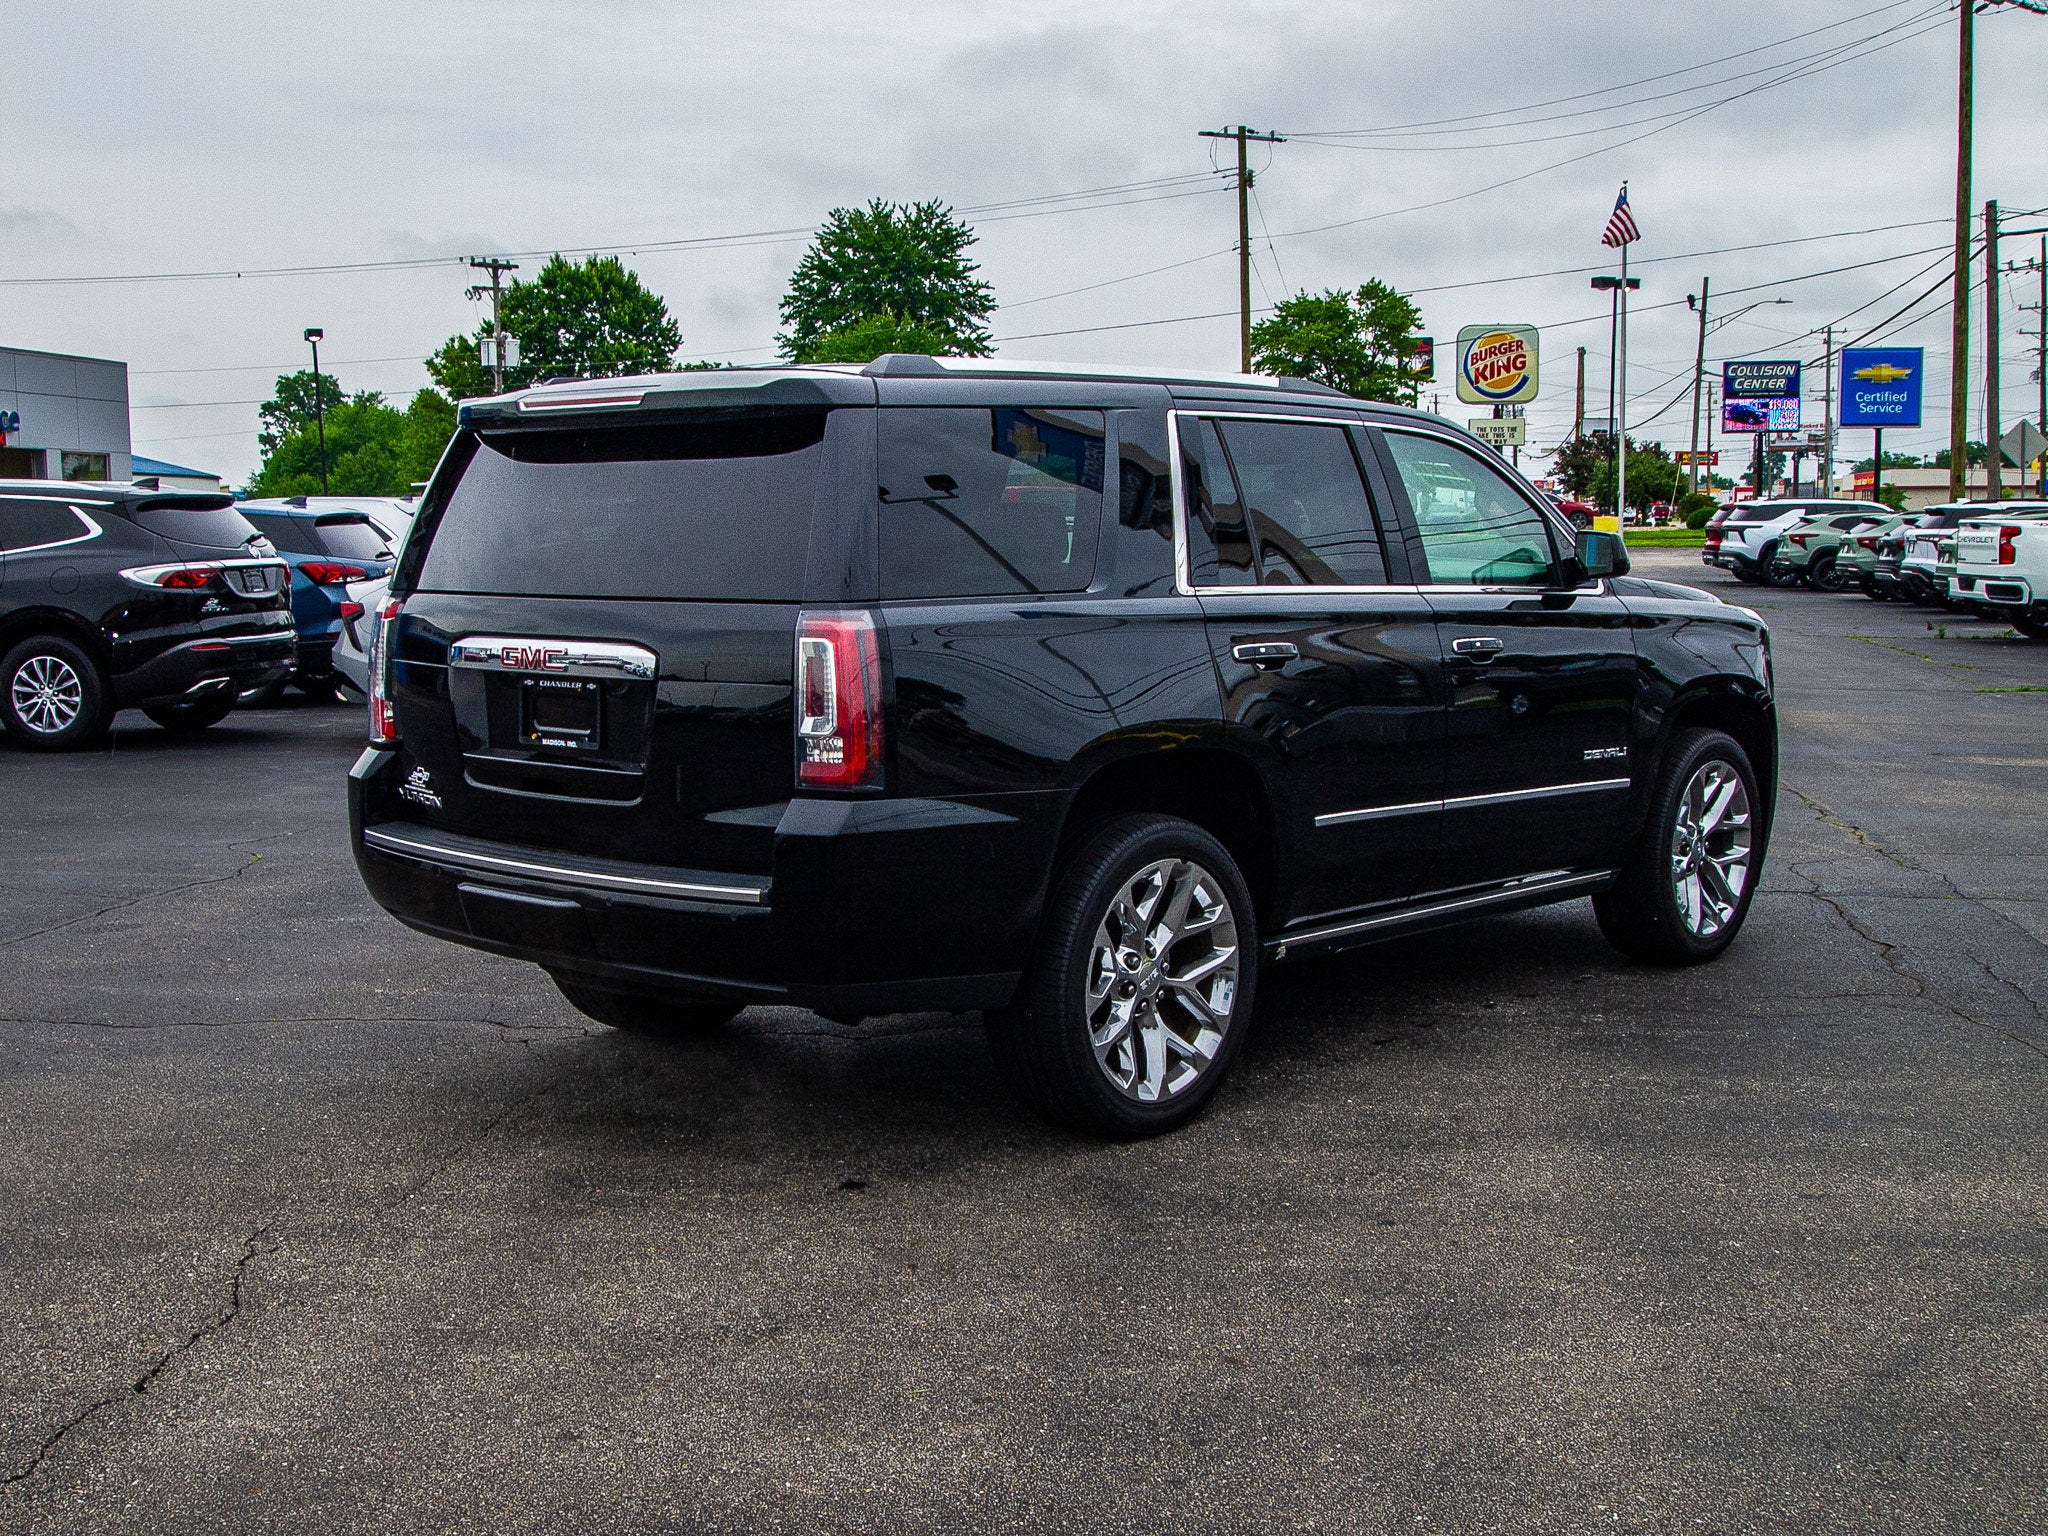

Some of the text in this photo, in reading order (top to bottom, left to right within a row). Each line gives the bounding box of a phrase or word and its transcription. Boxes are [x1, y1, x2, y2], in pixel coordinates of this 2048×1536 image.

[1470, 339, 1524, 366] BURGER
[1474, 353, 1527, 385] KING
[1728, 365, 1796, 376] COLLISION
[1734, 378, 1786, 389] CENTER
[1855, 391, 1907, 402] Certified
[1859, 402, 1903, 413] Service
[501, 646, 566, 671] GMC
[539, 680, 582, 689] CHANDLER
[1583, 746, 1627, 760] DENALI
